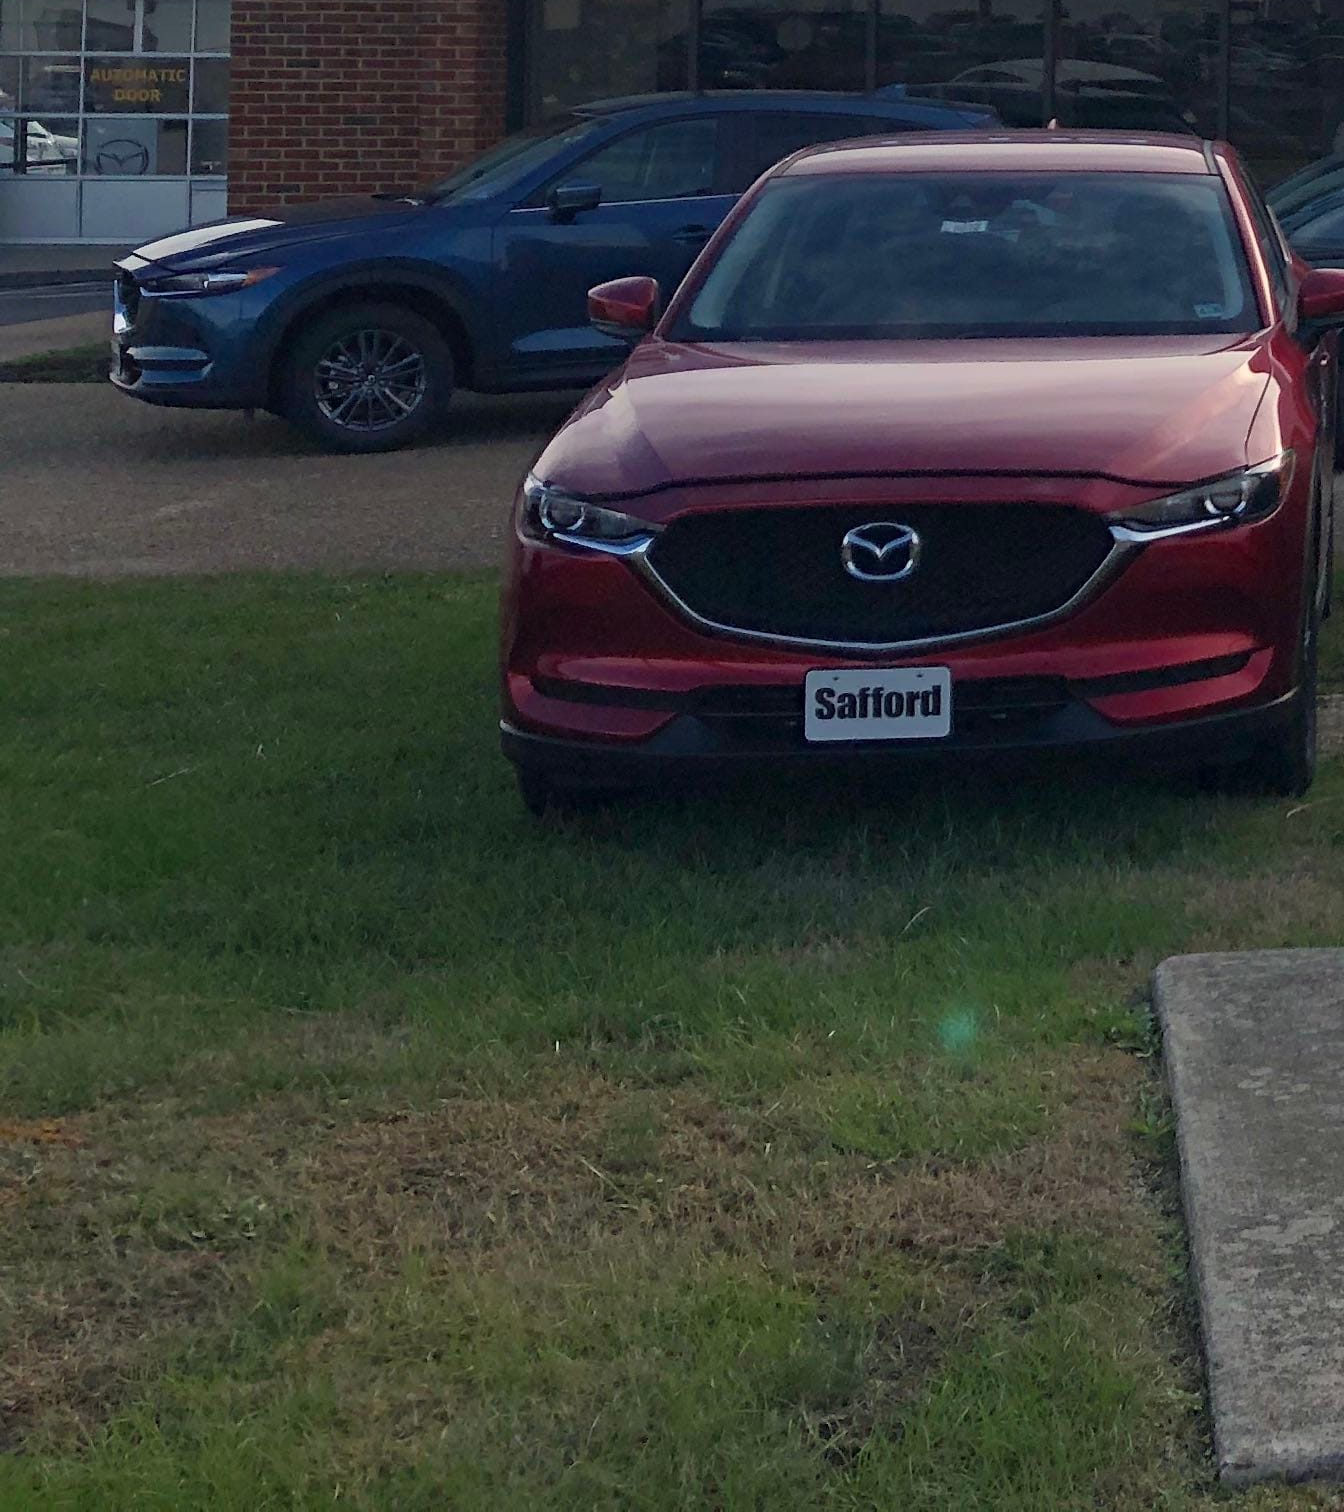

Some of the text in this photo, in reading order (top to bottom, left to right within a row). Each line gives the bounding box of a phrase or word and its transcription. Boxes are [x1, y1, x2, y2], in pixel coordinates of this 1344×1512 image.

[90, 68, 186, 83] AUTOMATIC
[114, 88, 161, 102] DOOR
[815, 685, 942, 720] Safford
